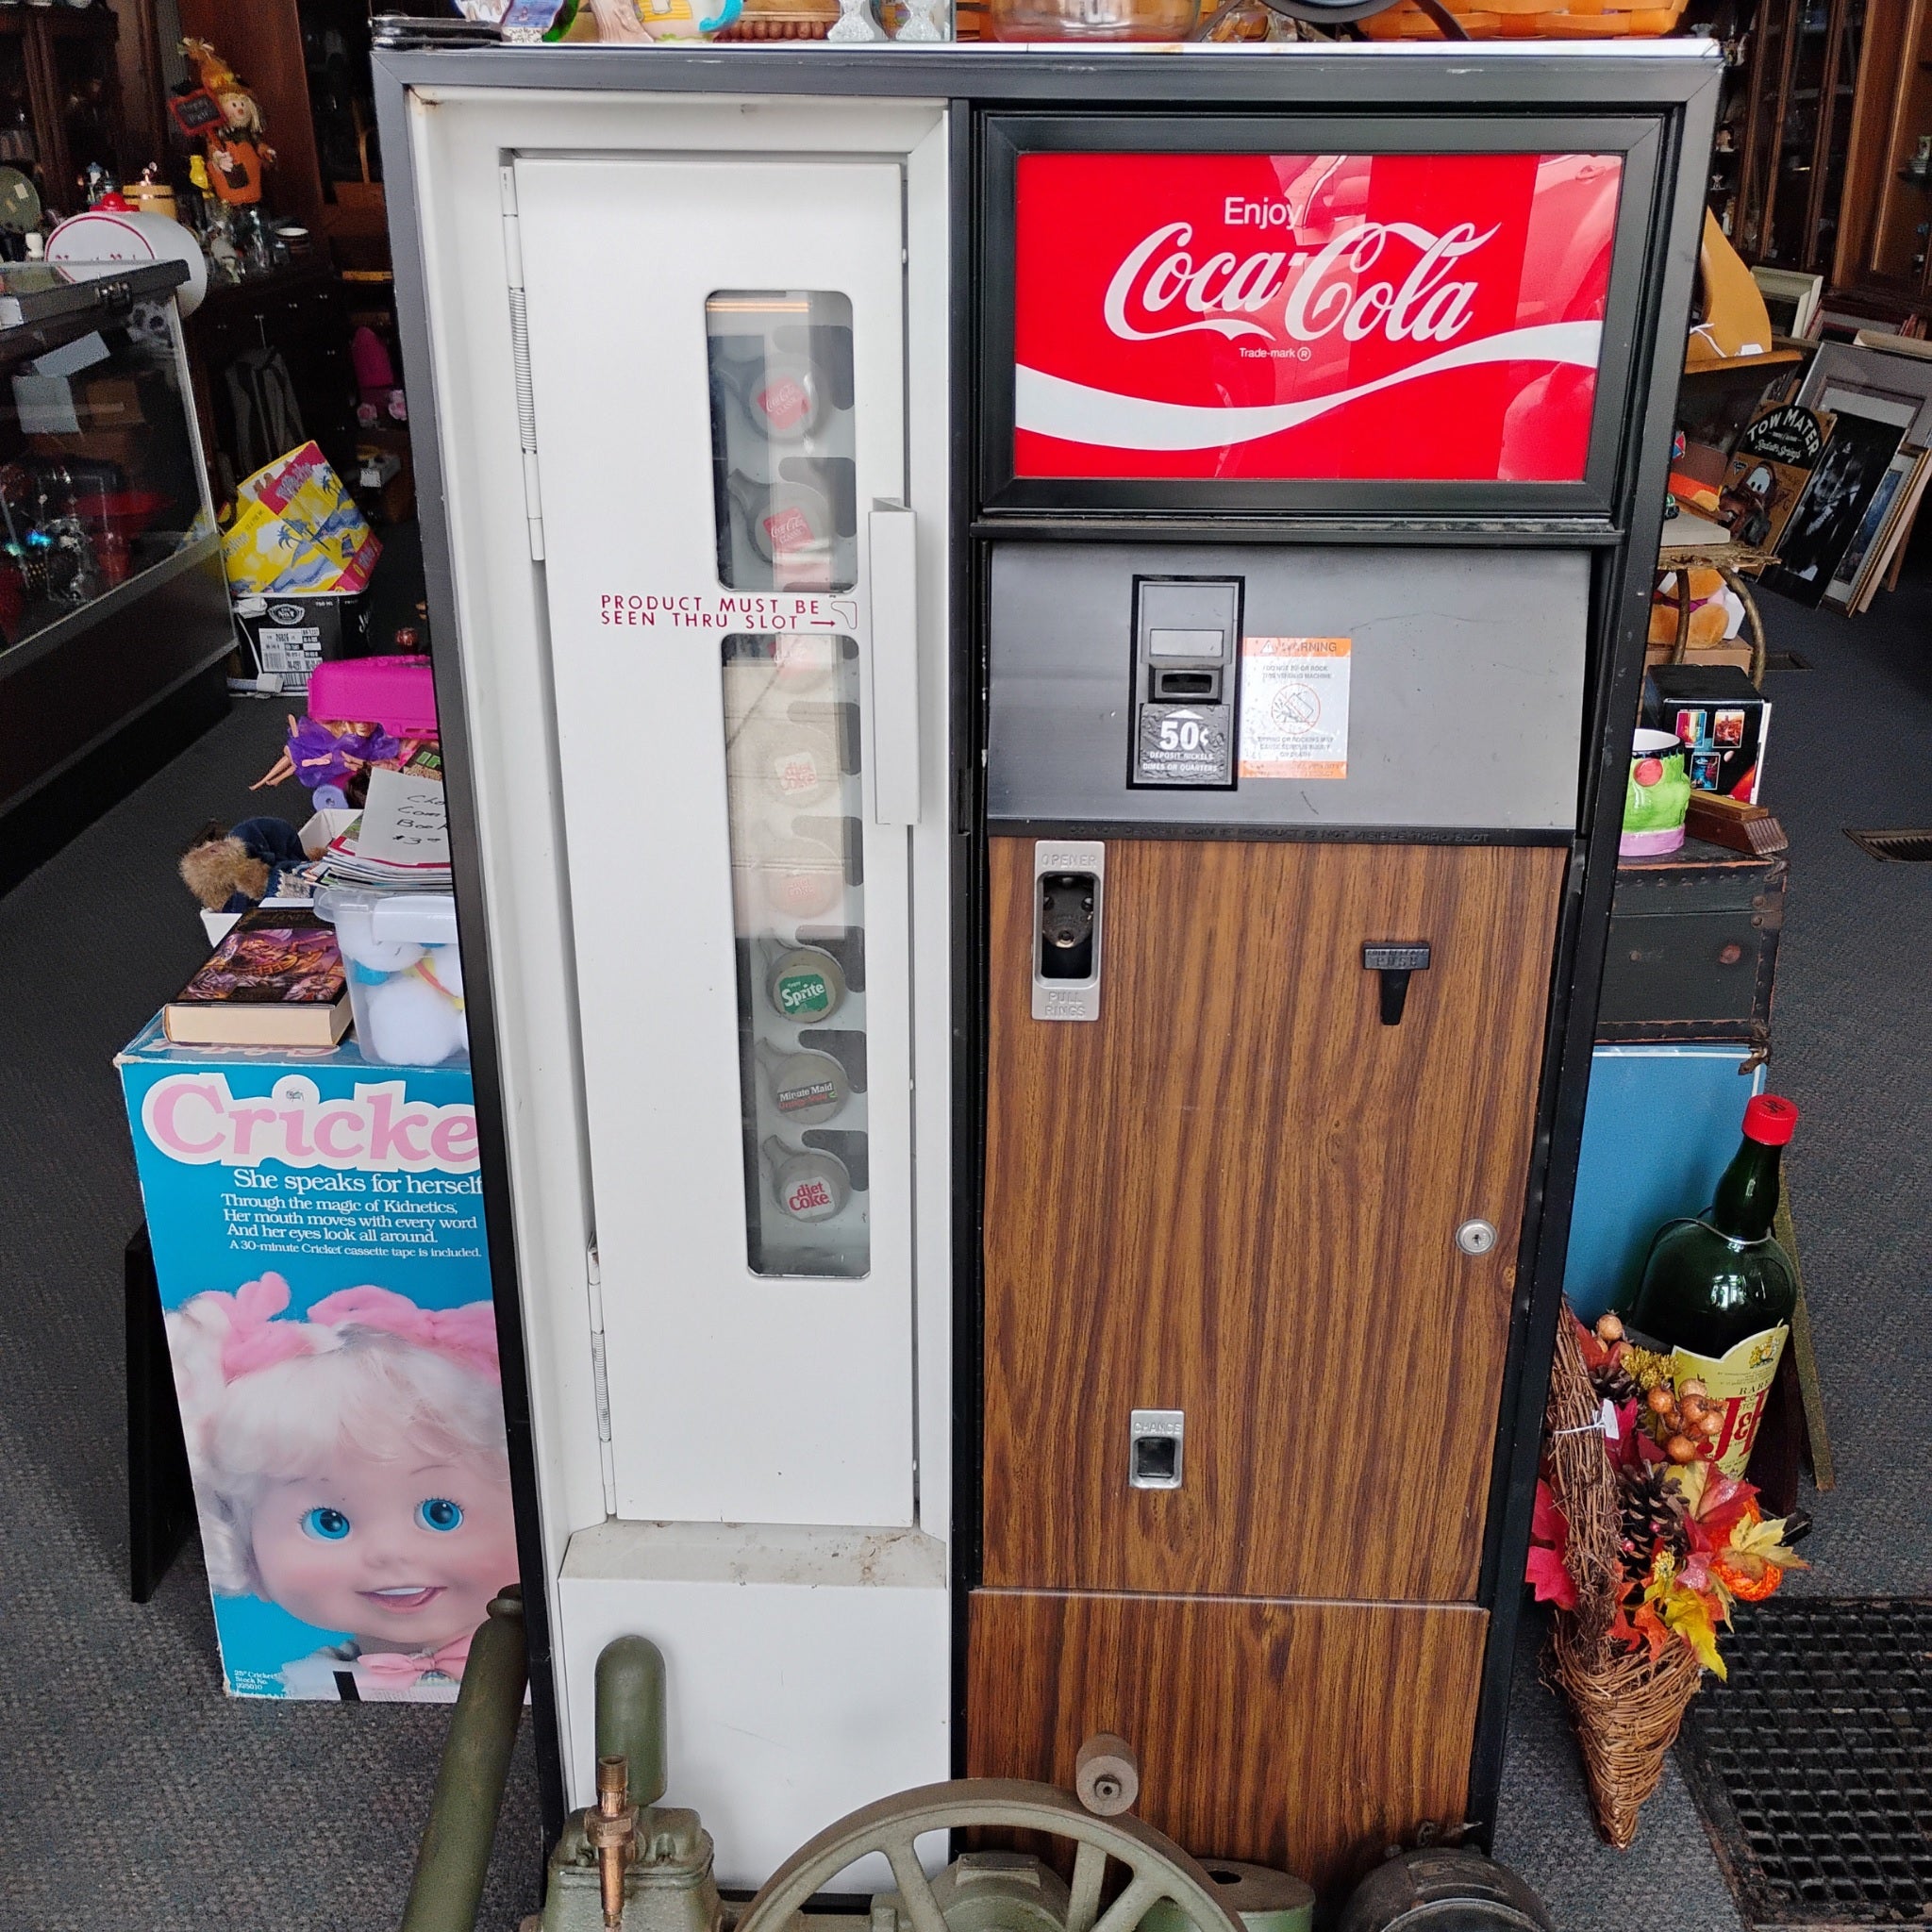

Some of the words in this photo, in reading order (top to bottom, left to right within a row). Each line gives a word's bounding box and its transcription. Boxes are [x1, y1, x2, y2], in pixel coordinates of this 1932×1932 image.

[1224, 197, 1302, 229] Enjoy
[1104, 222, 1502, 341] Coca-Cola
[1239, 347, 1296, 358] Trade-mark
[1747, 412, 1782, 441] TOW
[1783, 408, 1820, 457] MATER
[601, 594, 702, 611] PRODUCT
[719, 598, 779, 614] MUST
[795, 600, 820, 615] BE
[601, 610, 656, 626] SEEN
[673, 612, 728, 628] THRU
[745, 615, 798, 629] SLOT
[1282, 642, 1337, 652] RNING
[1150, 751, 1181, 760] DEPOSIT
[1179, 763, 1218, 772] QUARTERS
[1357, 831, 1407, 841] VISIBLE
[1455, 833, 1490, 842] SLOT
[1041, 854, 1096, 868] OPENER
[782, 983, 825, 1007] Sprite
[1048, 991, 1084, 1004] PULL
[1044, 1006, 1086, 1019] RINGS
[779, 1089, 809, 1102] Minute
[810, 1082, 834, 1095] Maid
[152, 1083, 479, 1163] Cricke
[234, 1168, 279, 1189] She
[284, 1172, 366, 1194] speaks
[371, 1174, 402, 1192] for
[405, 1174, 483, 1194] herself
[796, 1182, 825, 1198] diet
[221, 1193, 286, 1211] Through
[289, 1196, 313, 1209] the
[316, 1199, 362, 1214] magic
[364, 1199, 381, 1212] of
[789, 1191, 830, 1211] Coke
[224, 1208, 251, 1222] Her
[254, 1212, 304, 1224] mouth
[307, 1215, 357, 1226] moves
[358, 1215, 392, 1227] with
[395, 1219, 435, 1231] every
[440, 1216, 478, 1228] word
[227, 1223, 259, 1237] And
[261, 1224, 287, 1238] her
[289, 1229, 322, 1241] eyes
[324, 1227, 356, 1241] look
[359, 1228, 377, 1241] all
[380, 1230, 439, 1242] around.
[229, 1240, 240, 1250] A
[241, 1240, 300, 1253] 30-minute
[301, 1243, 341, 1255] Cricket
[343, 1247, 390, 1257] cassette
[391, 1247, 416, 1258] tape
[419, 1248, 429, 1257] is
[431, 1247, 482, 1257] included.
[1133, 1422, 1183, 1435] CHANGE
